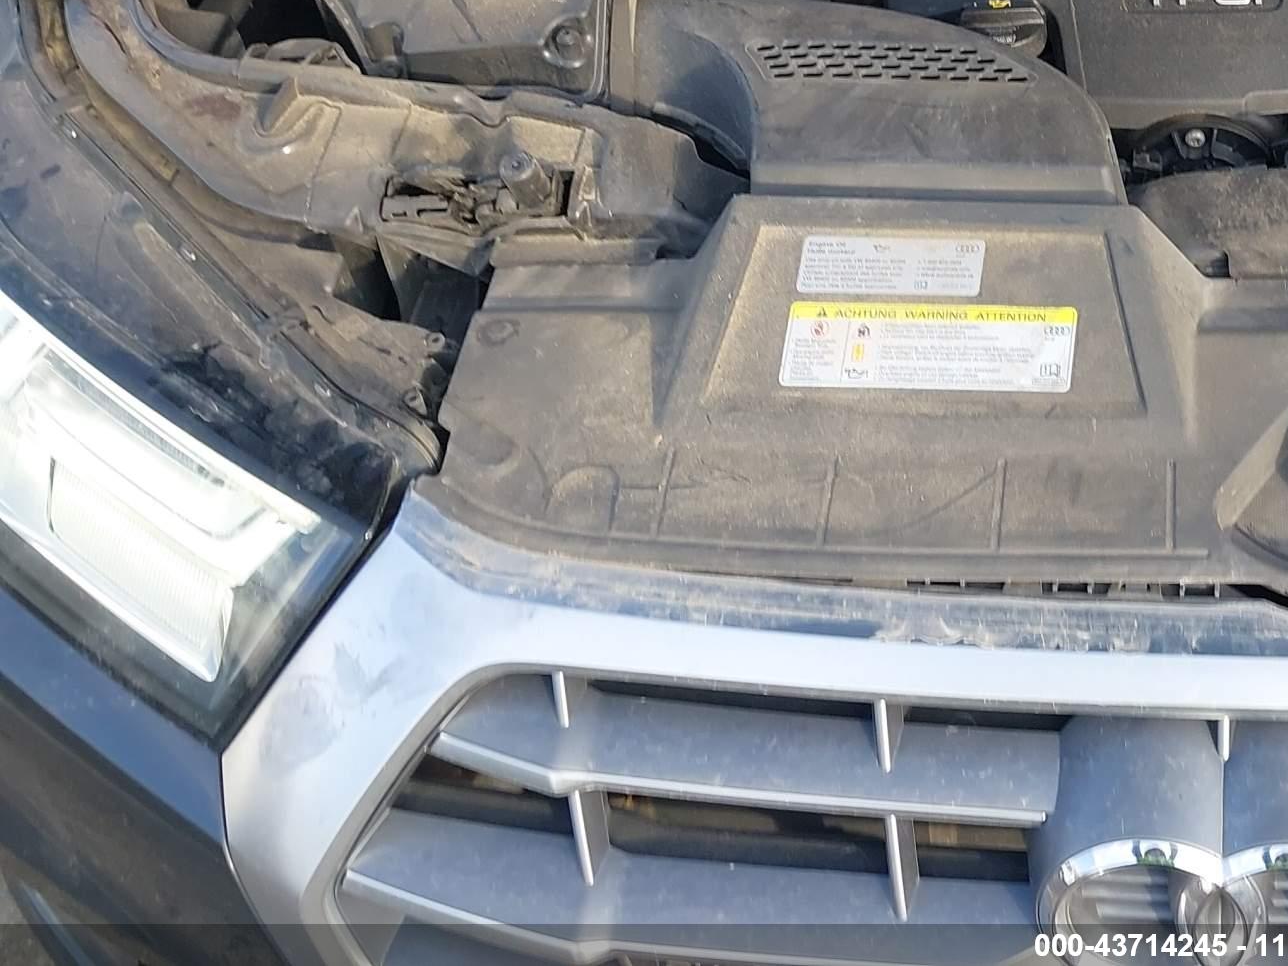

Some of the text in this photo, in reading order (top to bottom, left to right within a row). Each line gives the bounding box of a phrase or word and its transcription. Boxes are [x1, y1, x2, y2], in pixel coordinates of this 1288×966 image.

[836, 308, 1047, 323] ACHTUNG WARNING ATTENTION
